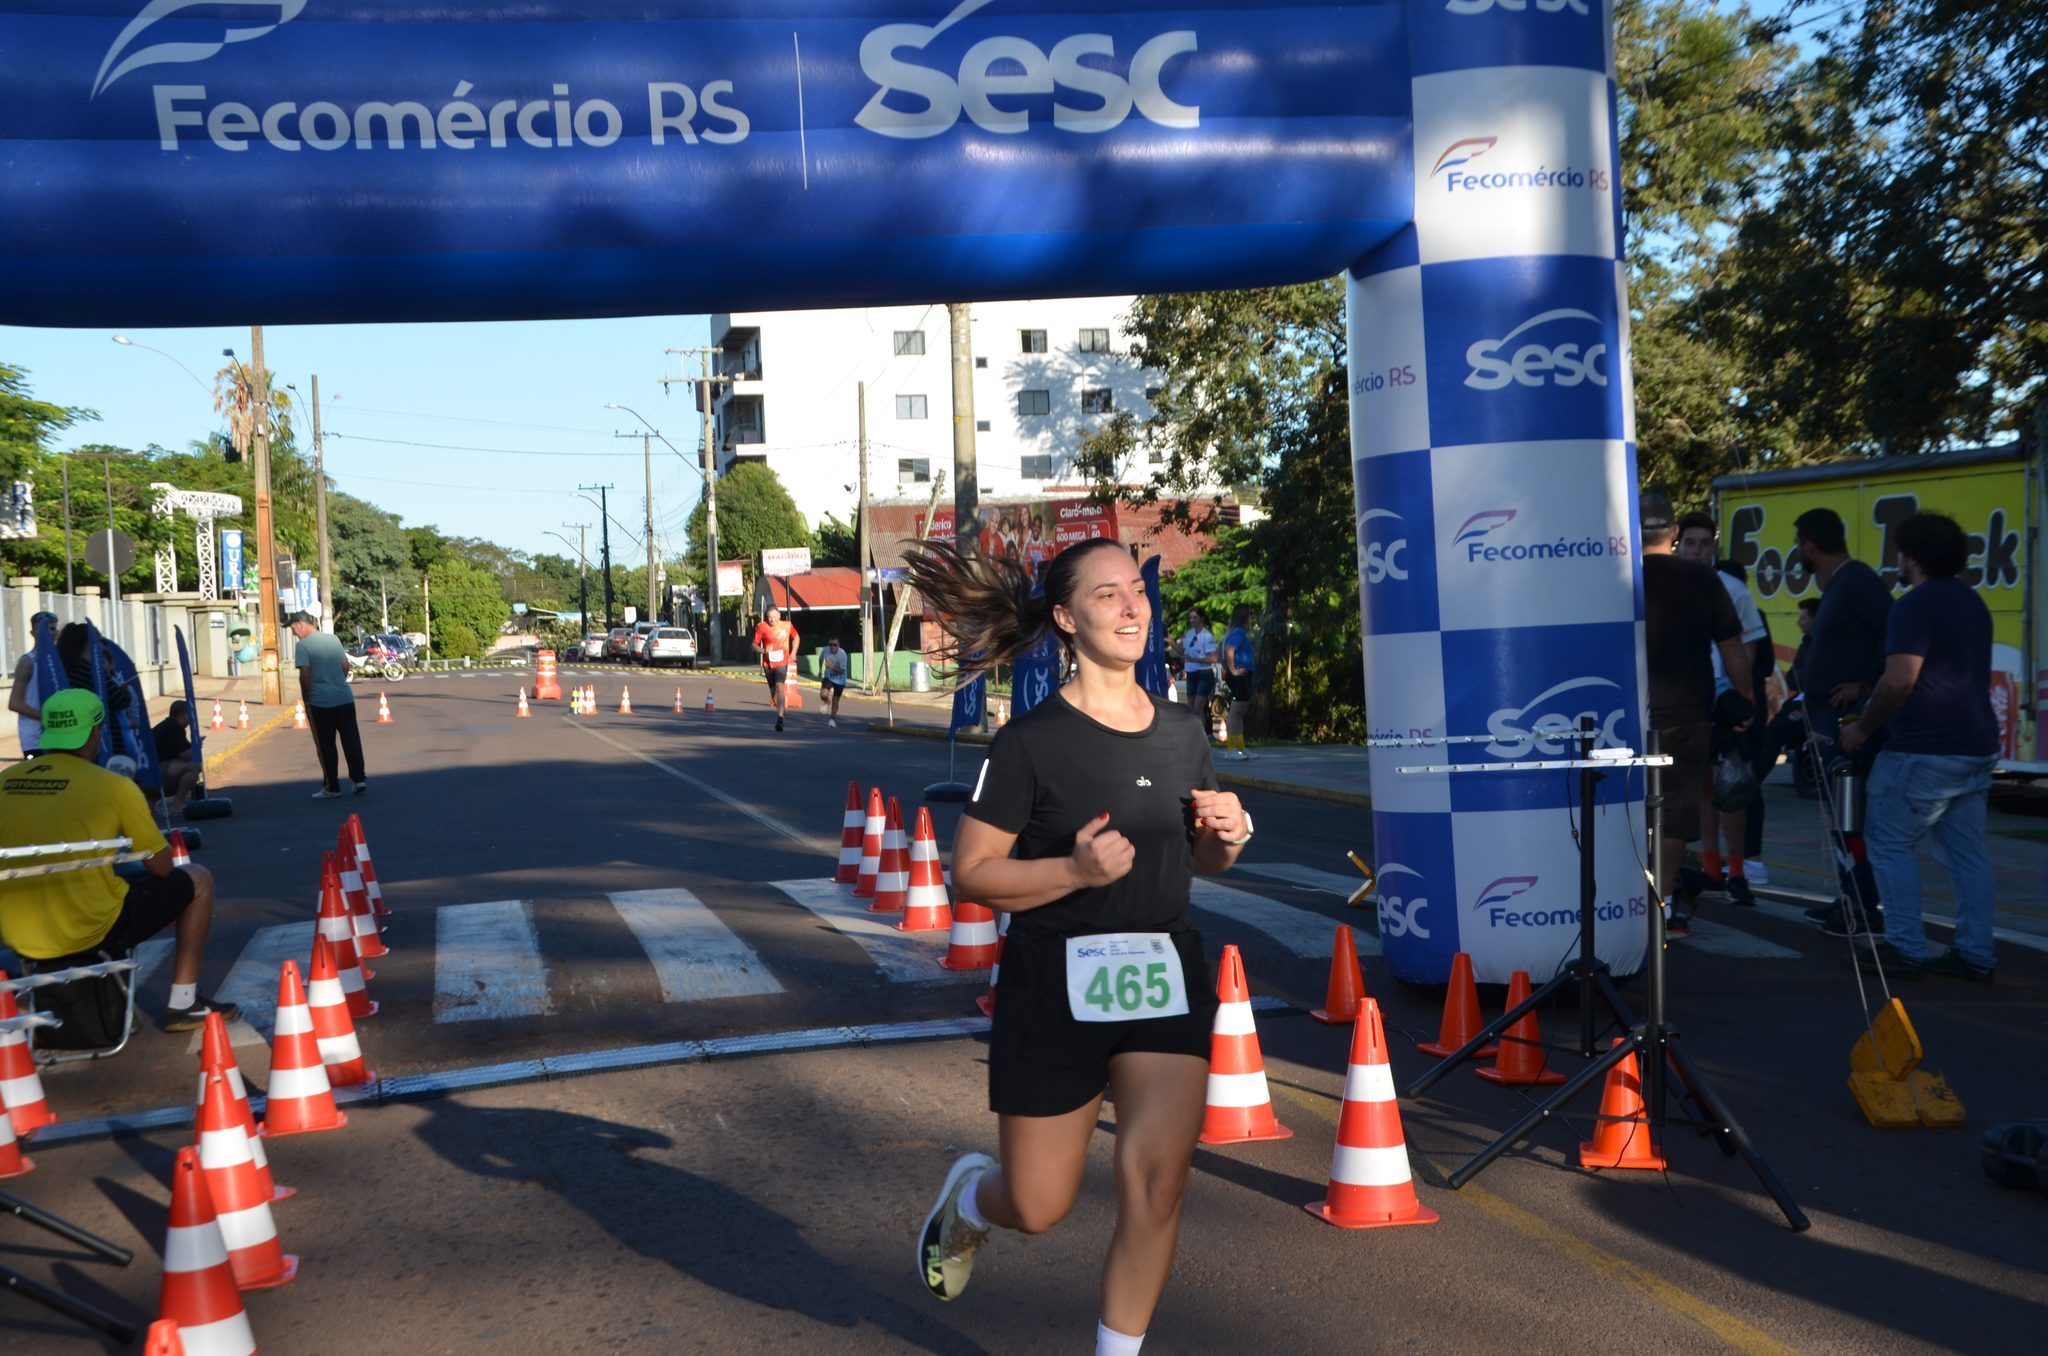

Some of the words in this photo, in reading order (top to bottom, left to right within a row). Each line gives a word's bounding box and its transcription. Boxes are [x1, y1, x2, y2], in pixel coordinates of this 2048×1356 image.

[153, 80, 622, 151] Fecomércio
[649, 80, 750, 146] RS
[1447, 165, 1584, 193] Fecomércio
[1589, 168, 1608, 192] RS
[1389, 365, 1416, 388] RS
[1069, 530, 1086, 542] MEGA
[1468, 537, 1604, 563] Fecomércio
[1608, 536, 1627, 557] RS
[227, 548, 241, 587] URI
[301, 582, 310, 609] URI
[1408, 728, 1437, 749] RS
[1628, 896, 1647, 918] RS
[1084, 962, 1171, 1013] 465
[926, 1243, 944, 1288] FILA
